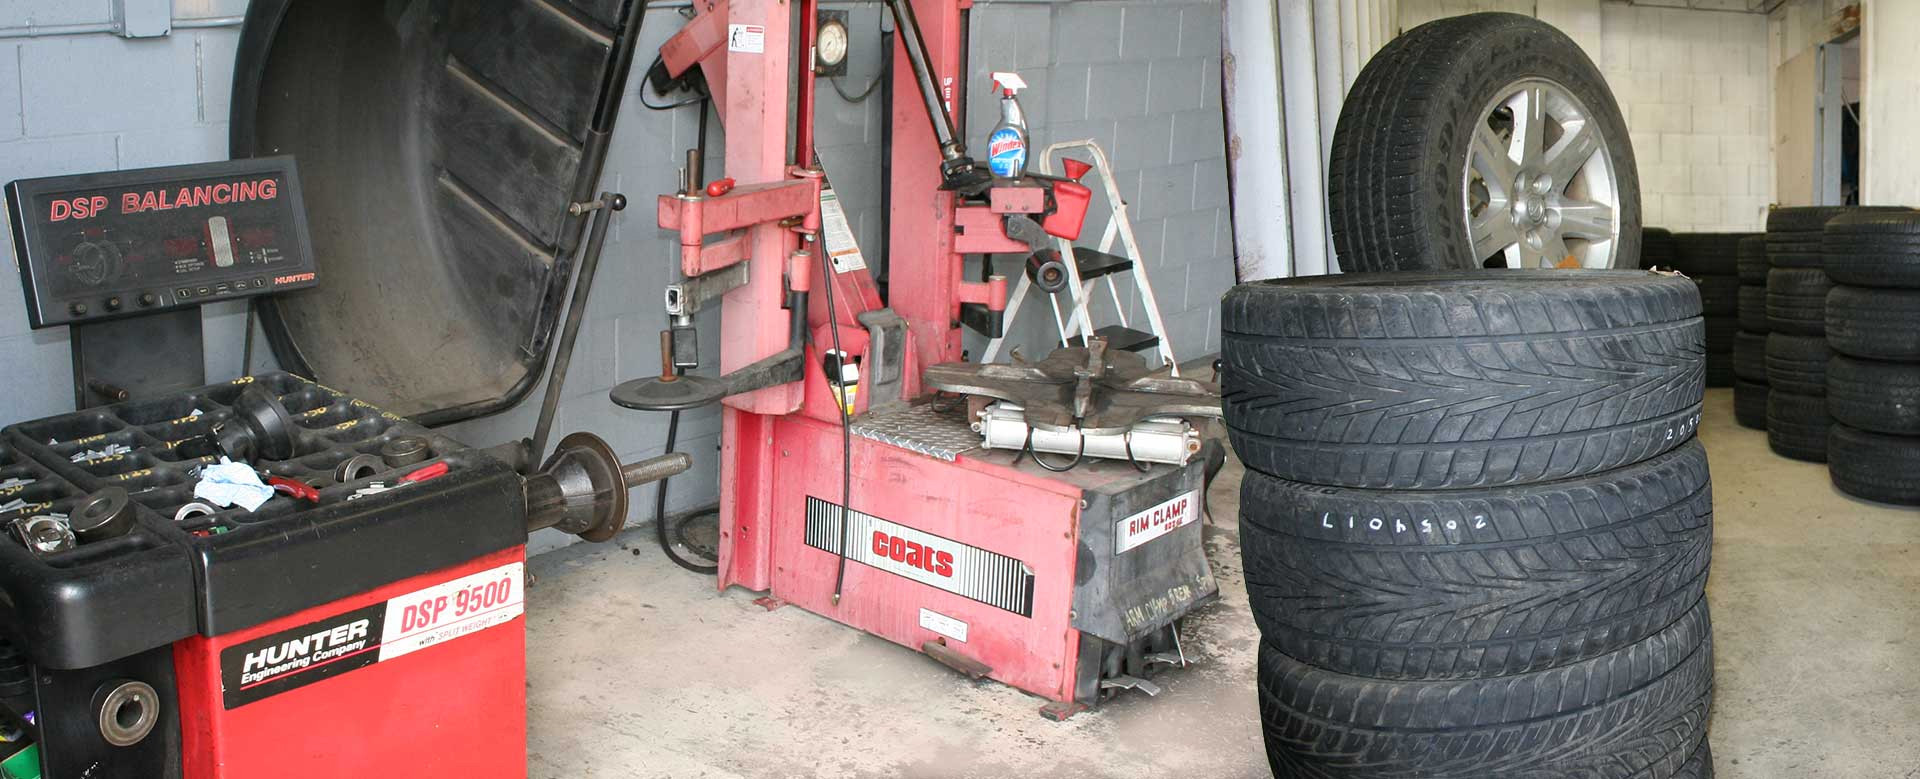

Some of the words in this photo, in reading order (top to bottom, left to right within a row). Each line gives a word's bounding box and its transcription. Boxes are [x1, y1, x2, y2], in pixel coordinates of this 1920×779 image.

[991, 139, 1024, 158] Windex
[50, 196, 109, 222] DSP
[121, 178, 278, 215] BALANCING
[274, 272, 316, 285] HUNTER
[1129, 515, 1150, 537] RIM
[1153, 498, 1188, 527] CLAMP
[401, 595, 449, 633] DSP
[454, 577, 512, 617] 9500
[241, 654, 310, 685] Engineering
[312, 639, 366, 662] Company
[242, 618, 370, 673] HUNTER
